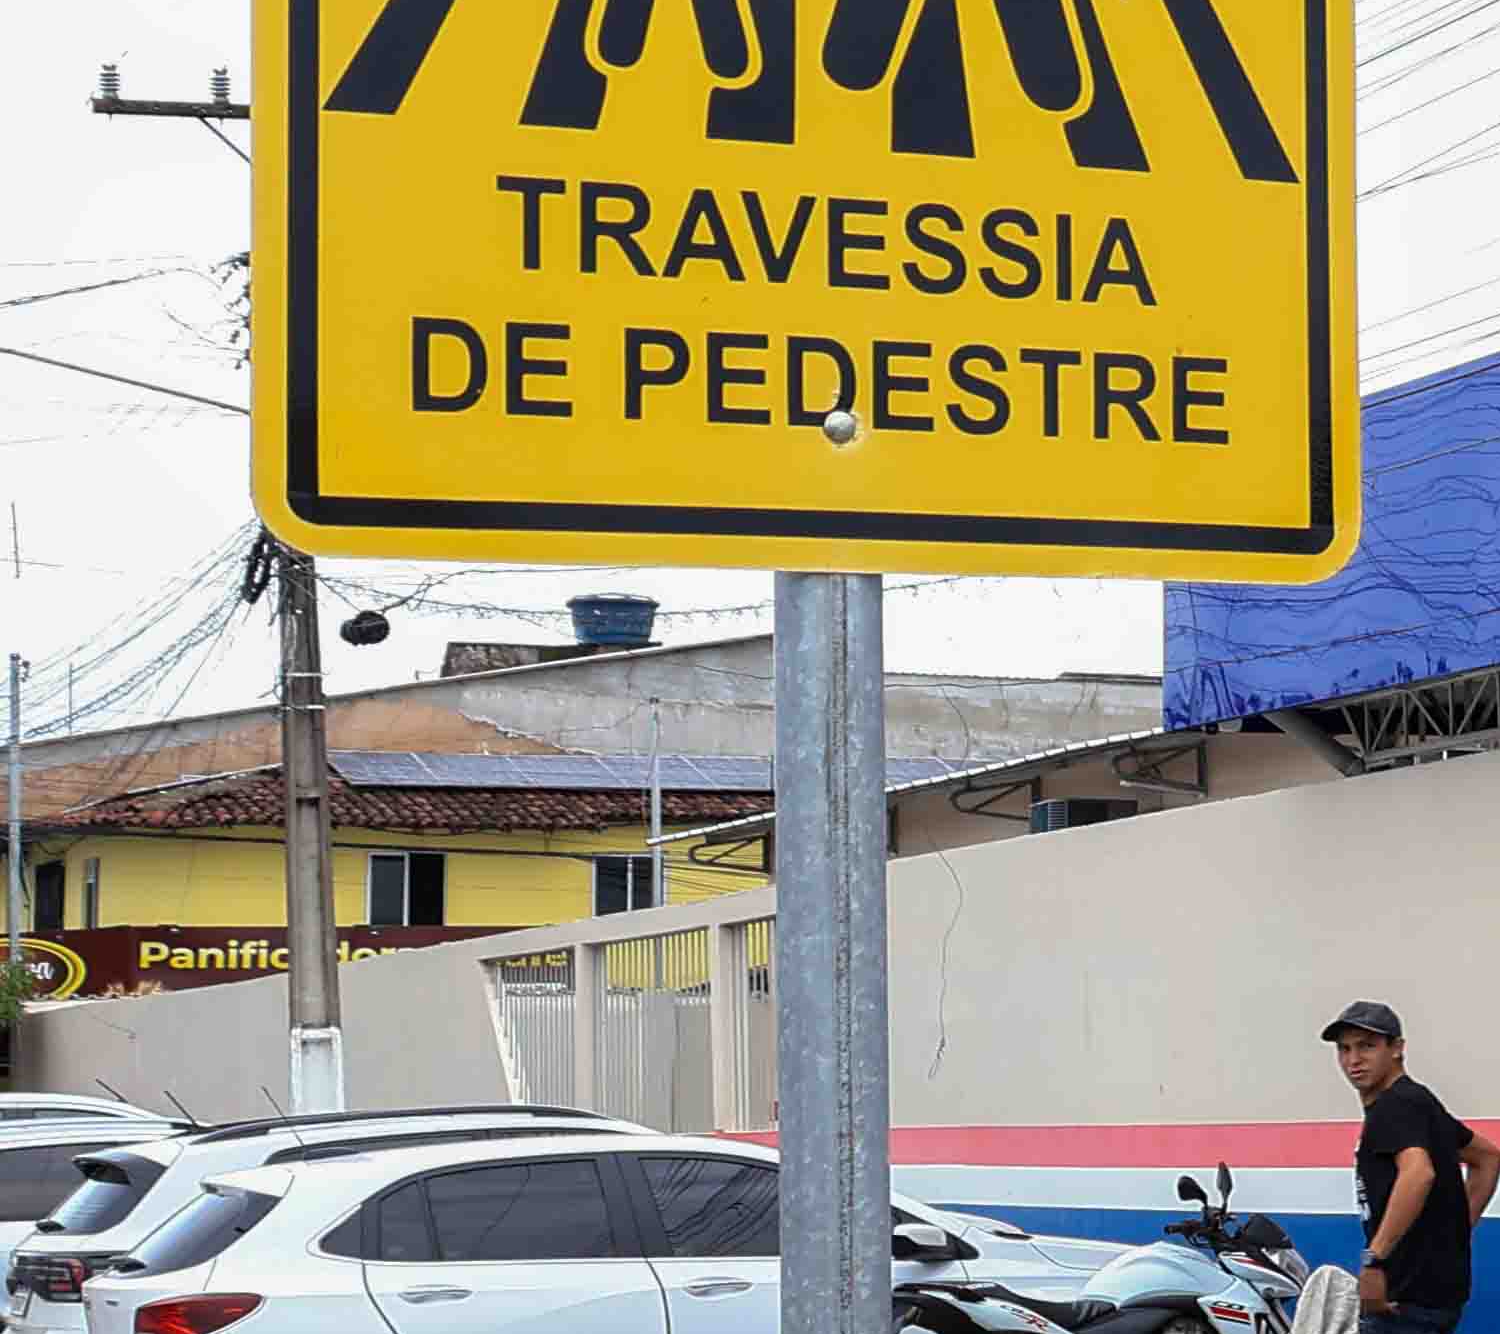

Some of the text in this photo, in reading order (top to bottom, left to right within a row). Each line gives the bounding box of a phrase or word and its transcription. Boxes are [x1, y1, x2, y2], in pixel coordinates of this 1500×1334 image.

[495, 173, 1158, 307] TRAVESSIA
[411, 315, 1231, 446] DE PEDESTRE
